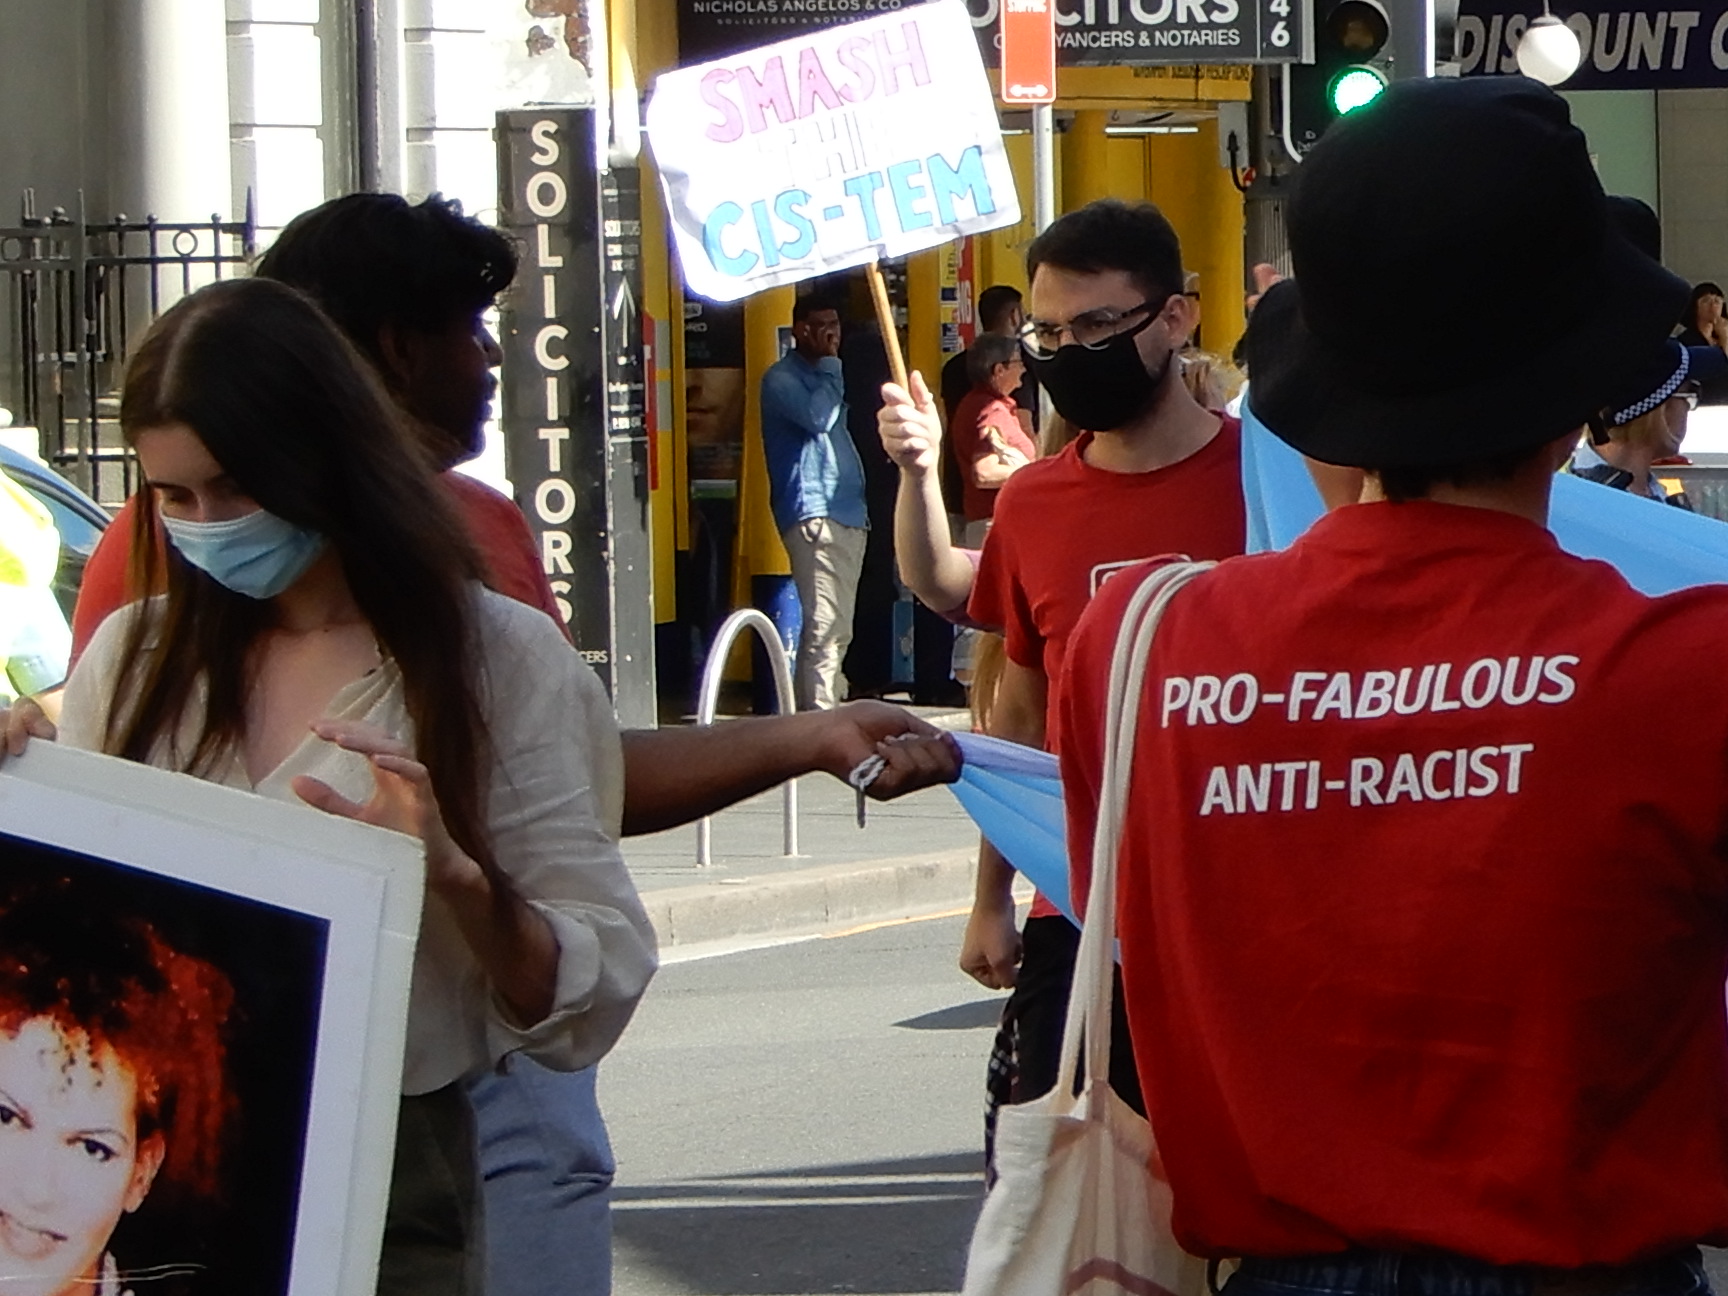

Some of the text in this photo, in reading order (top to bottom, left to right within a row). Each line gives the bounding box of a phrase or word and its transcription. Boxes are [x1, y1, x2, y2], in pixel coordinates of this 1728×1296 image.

[693, 0, 777, 13] NICHOLAS
[993, 28, 1240, 51] YANCERS & NOTARIES
[1459, 10, 1700, 75] DISOUNT
[699, 20, 932, 143] SMASH
[702, 144, 997, 277] CIS-TEM
[525, 119, 576, 625] SOLICITORS
[1161, 654, 1580, 729] PRO-FABULOUS
[1200, 742, 1535, 816] ANTI-RACIST
